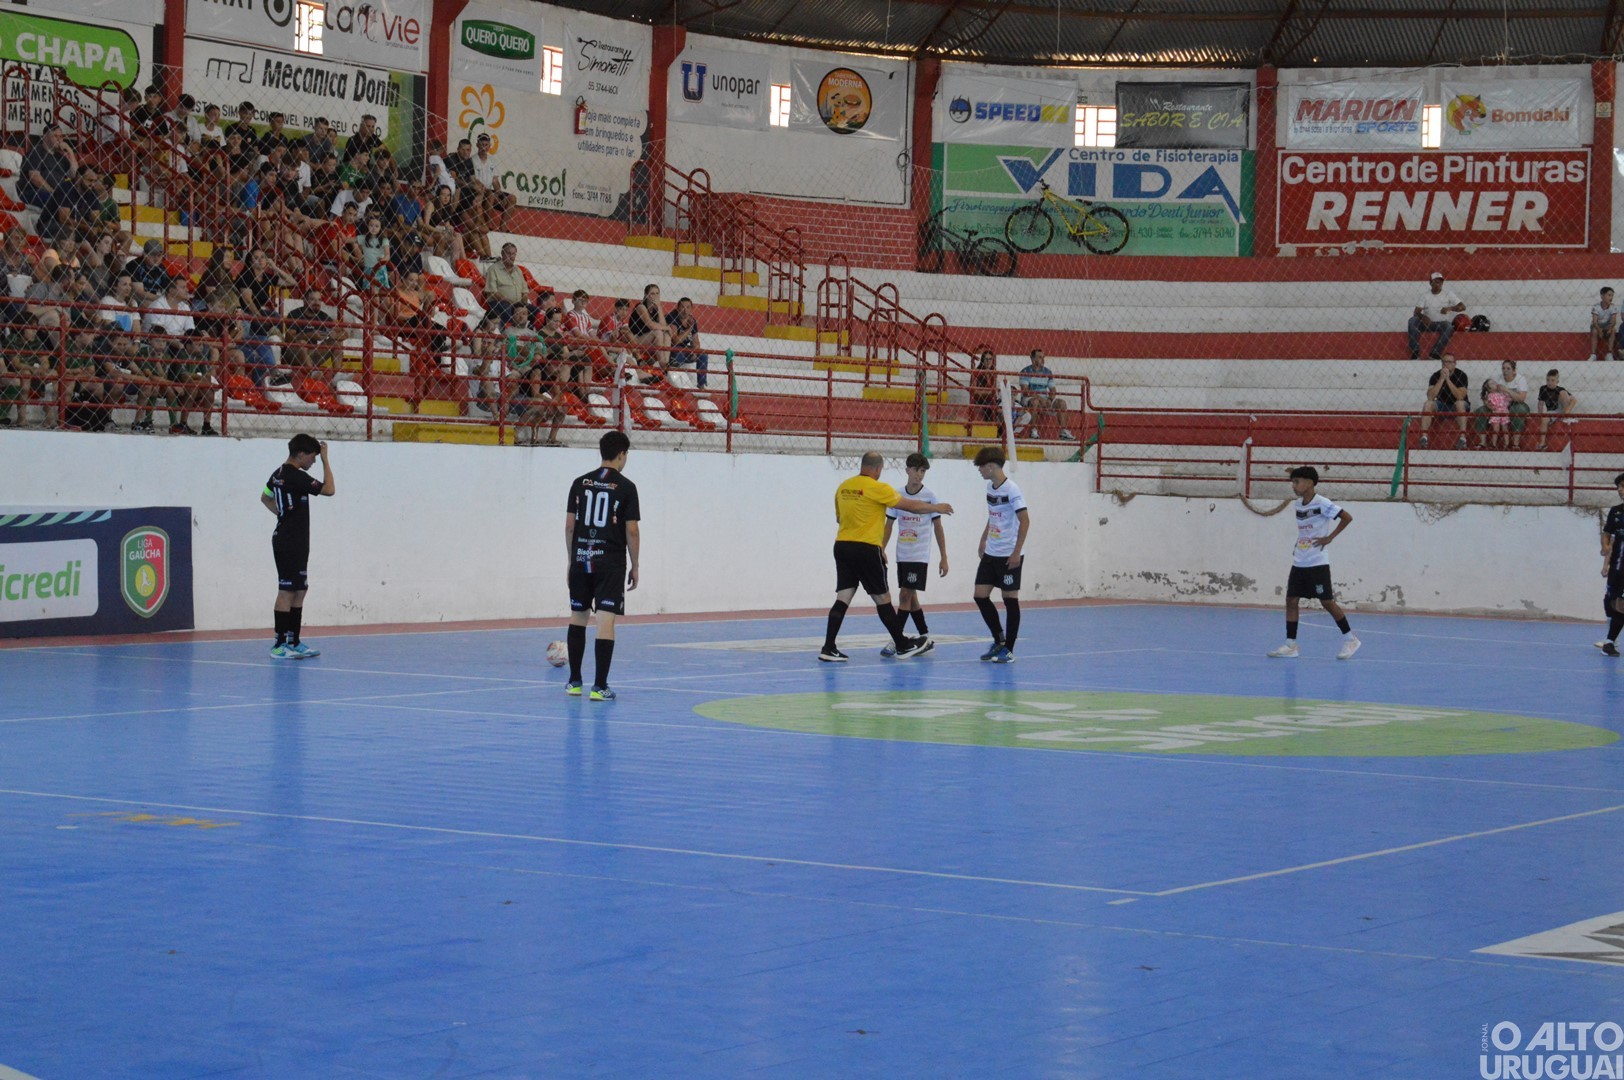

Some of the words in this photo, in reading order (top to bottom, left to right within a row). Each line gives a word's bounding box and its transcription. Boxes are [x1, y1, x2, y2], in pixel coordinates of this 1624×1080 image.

[466, 26, 497, 46] QUERO
[499, 33, 530, 53] QUERO
[16, 32, 126, 75] CHAPA
[577, 39, 634, 76] Simonetti
[353, 69, 401, 108] Donin
[713, 74, 760, 99] unopar
[828, 78, 863, 89] MODERNA
[613, 113, 641, 129] completa
[1120, 111, 1186, 129] SABOR
[1188, 112, 1203, 129] E
[1207, 112, 1246, 131] CIA
[1295, 98, 1419, 122] MARION
[1492, 108, 1570, 123] Bomdaki
[595, 127, 628, 143] brinquedos
[1355, 121, 1418, 134] SPORTS
[1069, 148, 1125, 161] Centro
[1132, 148, 1151, 162] de
[1156, 149, 1239, 165] Fisioterapia
[1282, 156, 1396, 184] Centro
[1400, 155, 1438, 184] de
[1443, 155, 1585, 184] Pinturas
[1001, 147, 1241, 223] VIDA
[528, 195, 564, 208] presentes
[1306, 191, 1549, 231] RENNER
[584, 489, 609, 528] 10
[129, 547, 161, 561] GAÚCHA
[137, 538, 153, 549] LIGA
